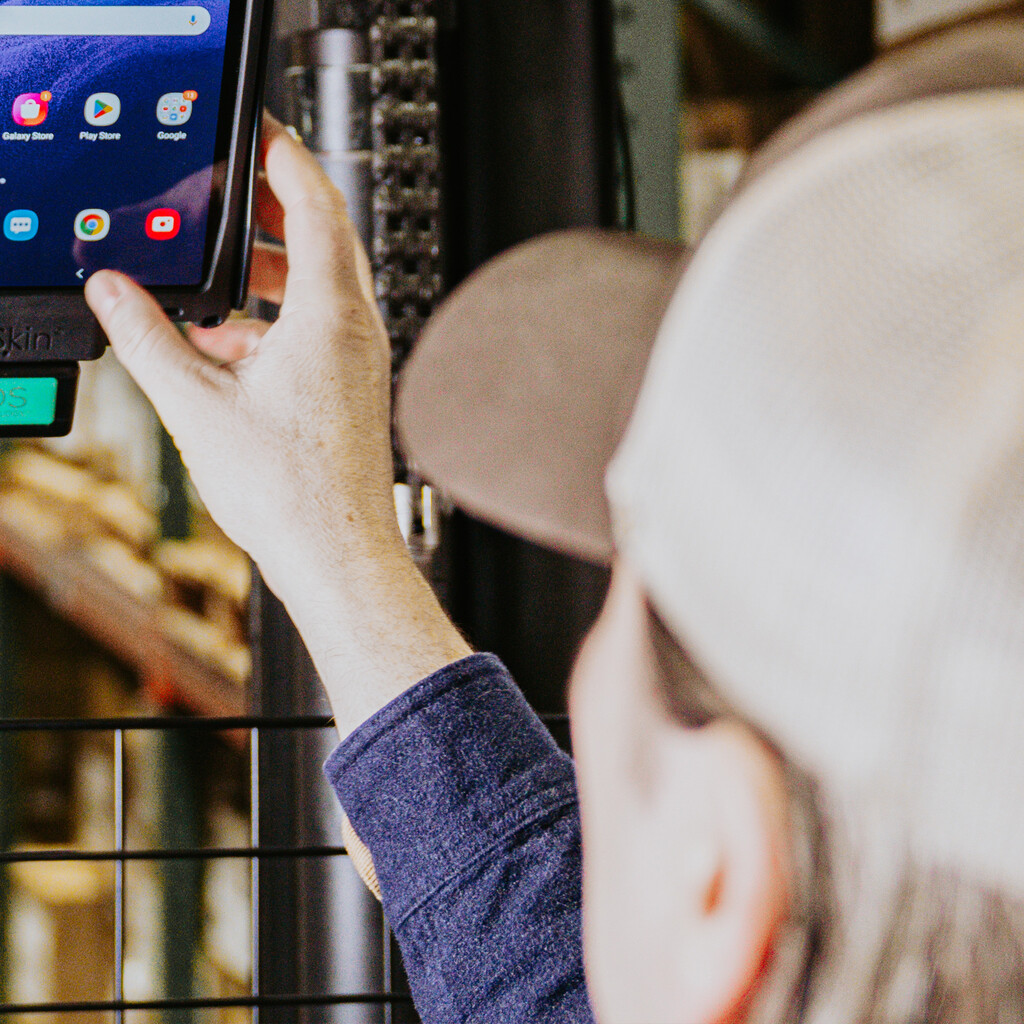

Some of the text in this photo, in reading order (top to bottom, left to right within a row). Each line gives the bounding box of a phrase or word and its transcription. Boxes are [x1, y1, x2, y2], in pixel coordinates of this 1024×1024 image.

[2, 131, 54, 142] Galaxy Store
[79, 131, 121, 142] Play Store
[156, 131, 188, 142] Google
